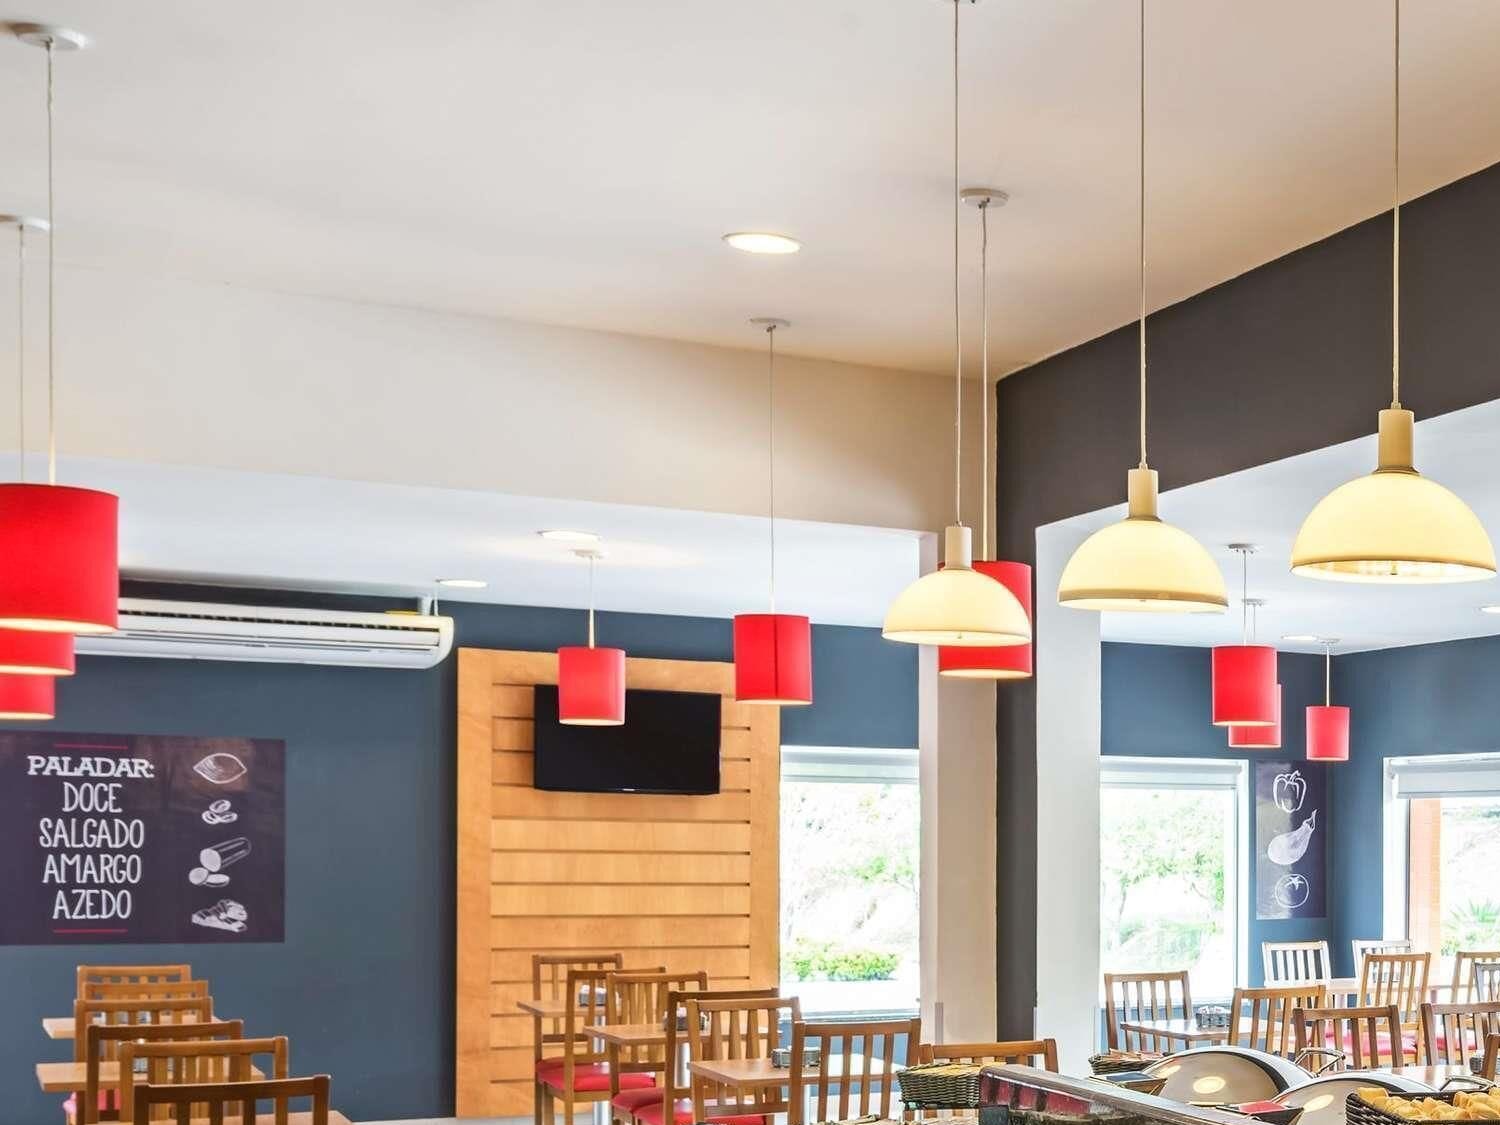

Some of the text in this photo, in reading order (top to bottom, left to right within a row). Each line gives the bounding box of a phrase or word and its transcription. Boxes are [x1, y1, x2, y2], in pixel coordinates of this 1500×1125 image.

[27, 755, 155, 779] PALADAR:
[62, 782, 123, 813] DOCE
[39, 818, 145, 848] SALGADO
[42, 854, 142, 884] AMARGO
[52, 890, 132, 919] AZEDO
